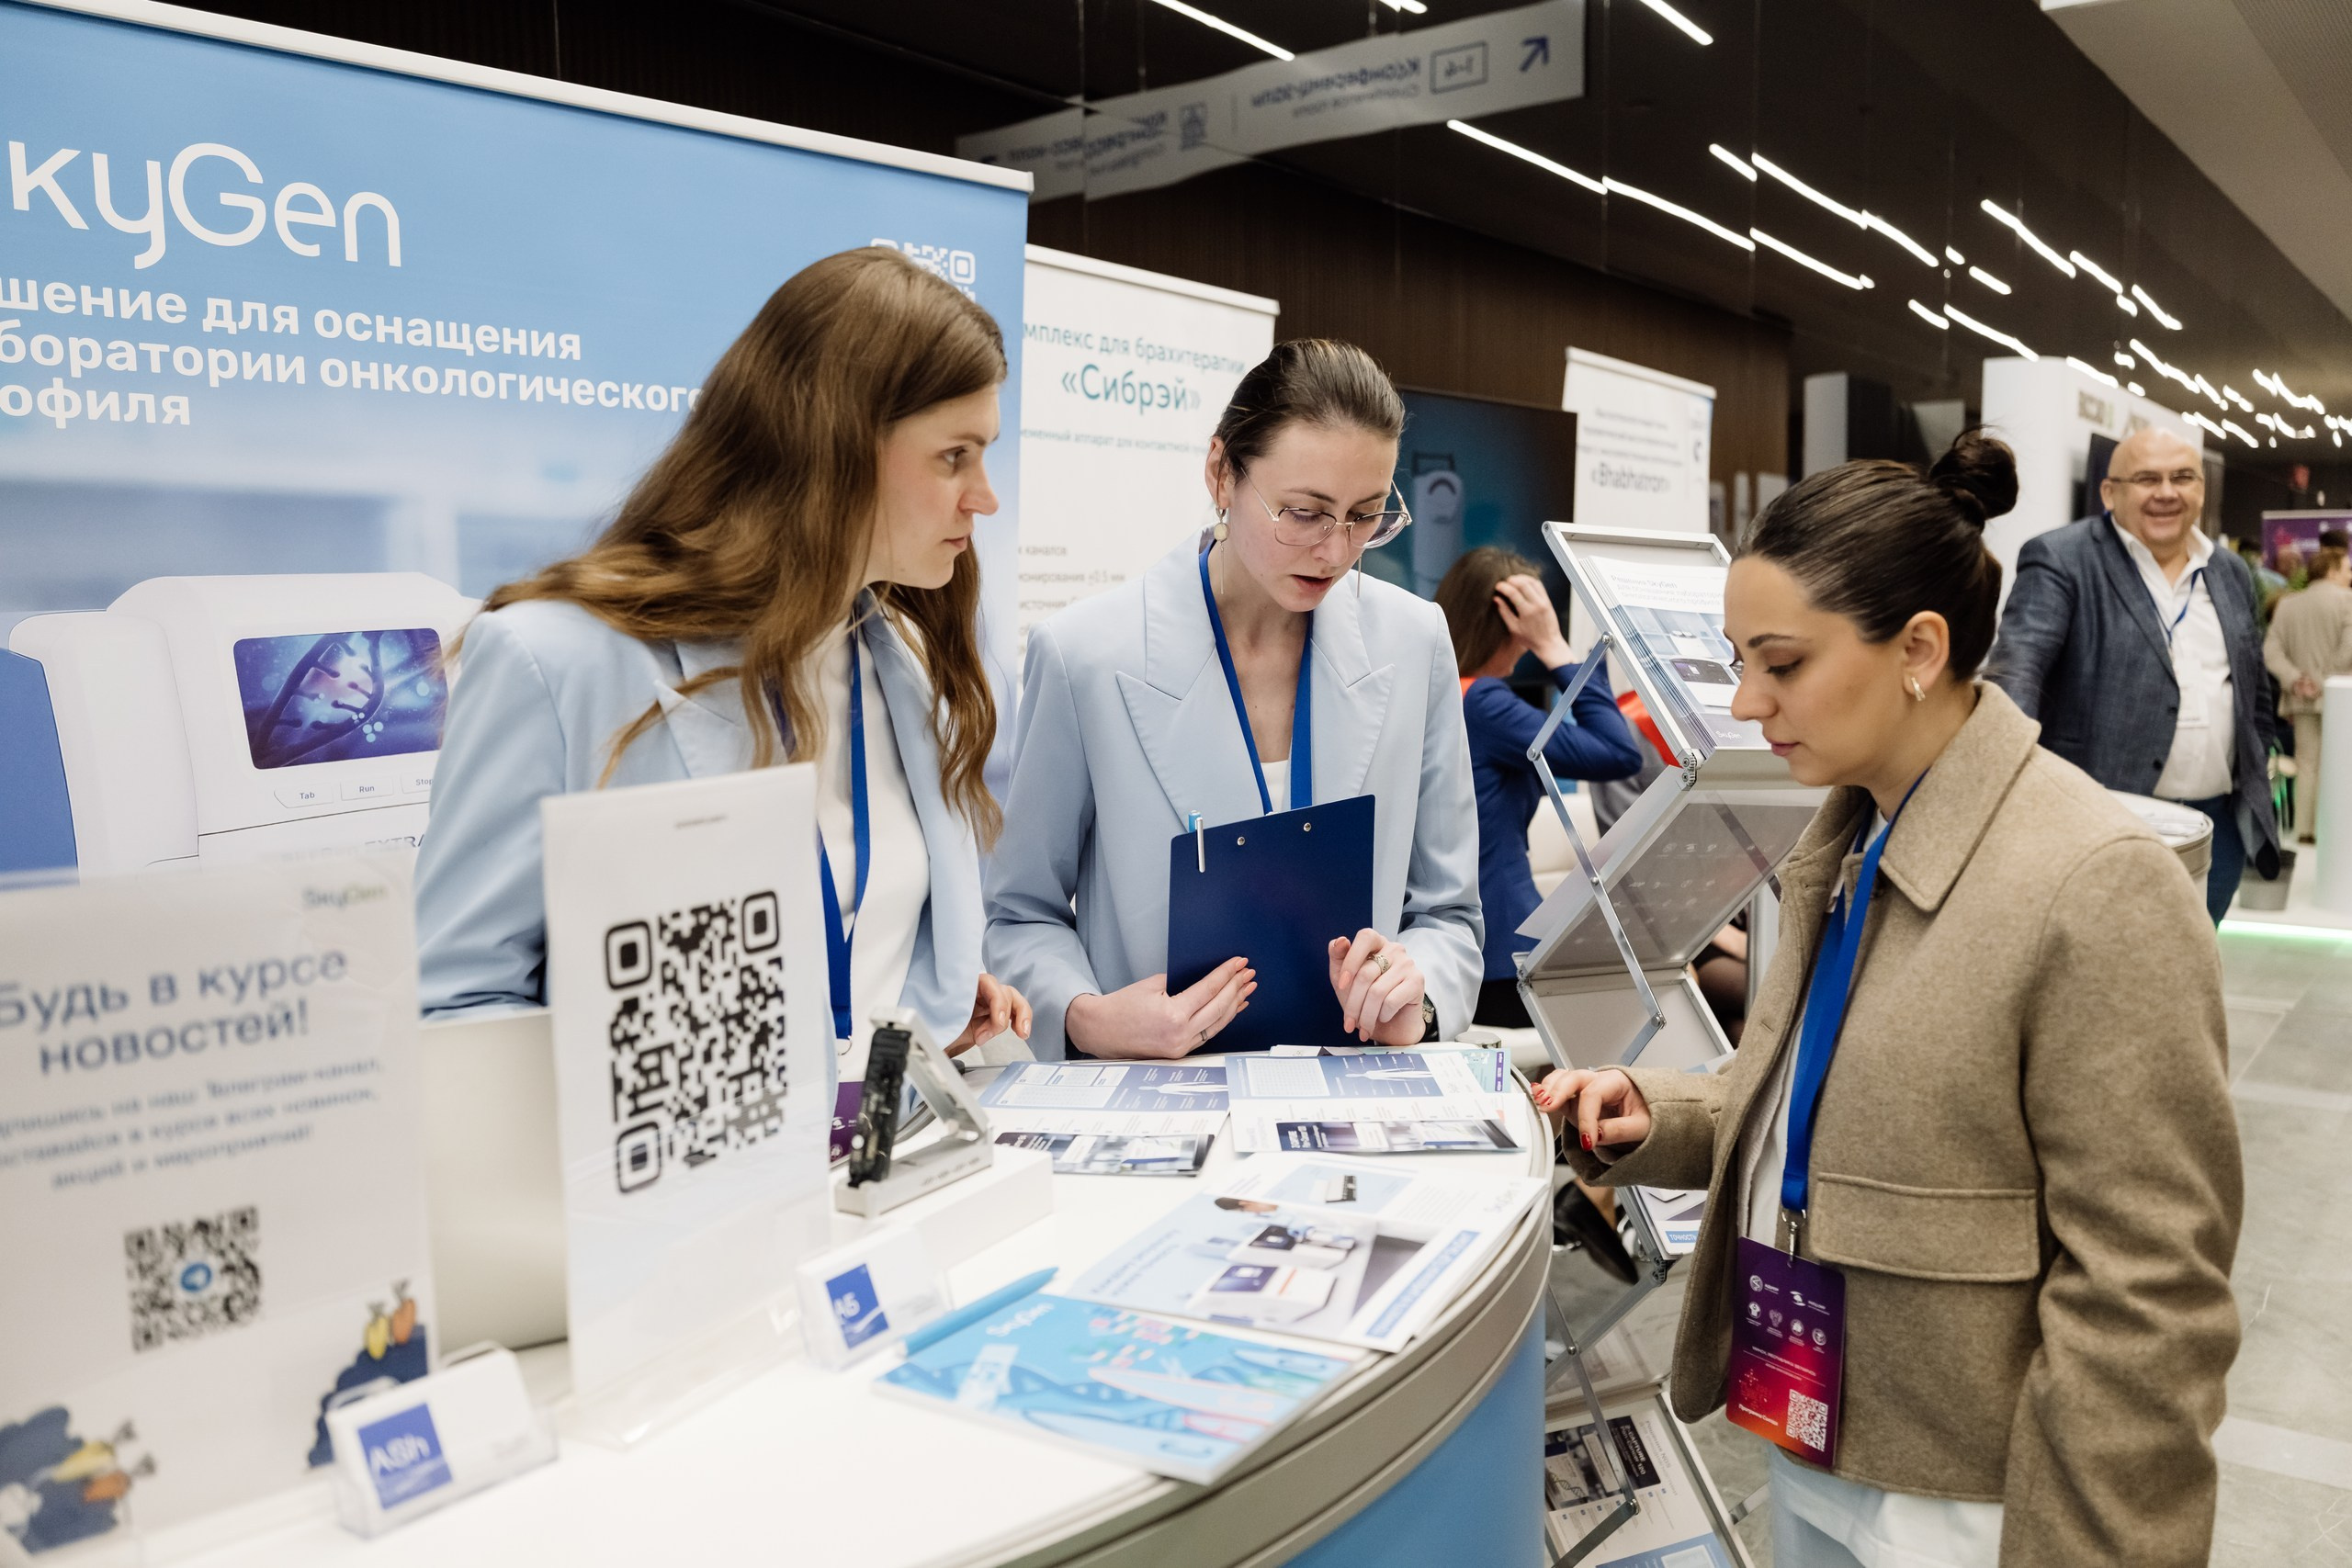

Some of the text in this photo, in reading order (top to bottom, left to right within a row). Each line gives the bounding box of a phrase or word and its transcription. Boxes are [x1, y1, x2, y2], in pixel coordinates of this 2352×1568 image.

[0, 277, 582, 360] шение для оснащения
[0, 319, 305, 388] боратории
[1099, 334, 1130, 356] для
[1135, 337, 1246, 375] брахитерапии
[0, 378, 190, 429] офиля
[1061, 363, 1202, 415] «Сибрэй»
[300, 791, 315, 800] Tab
[359, 784, 375, 794] Run
[148, 974, 179, 1007] в
[198, 950, 347, 1005] курсе
[40, 997, 310, 1075] новостей!
